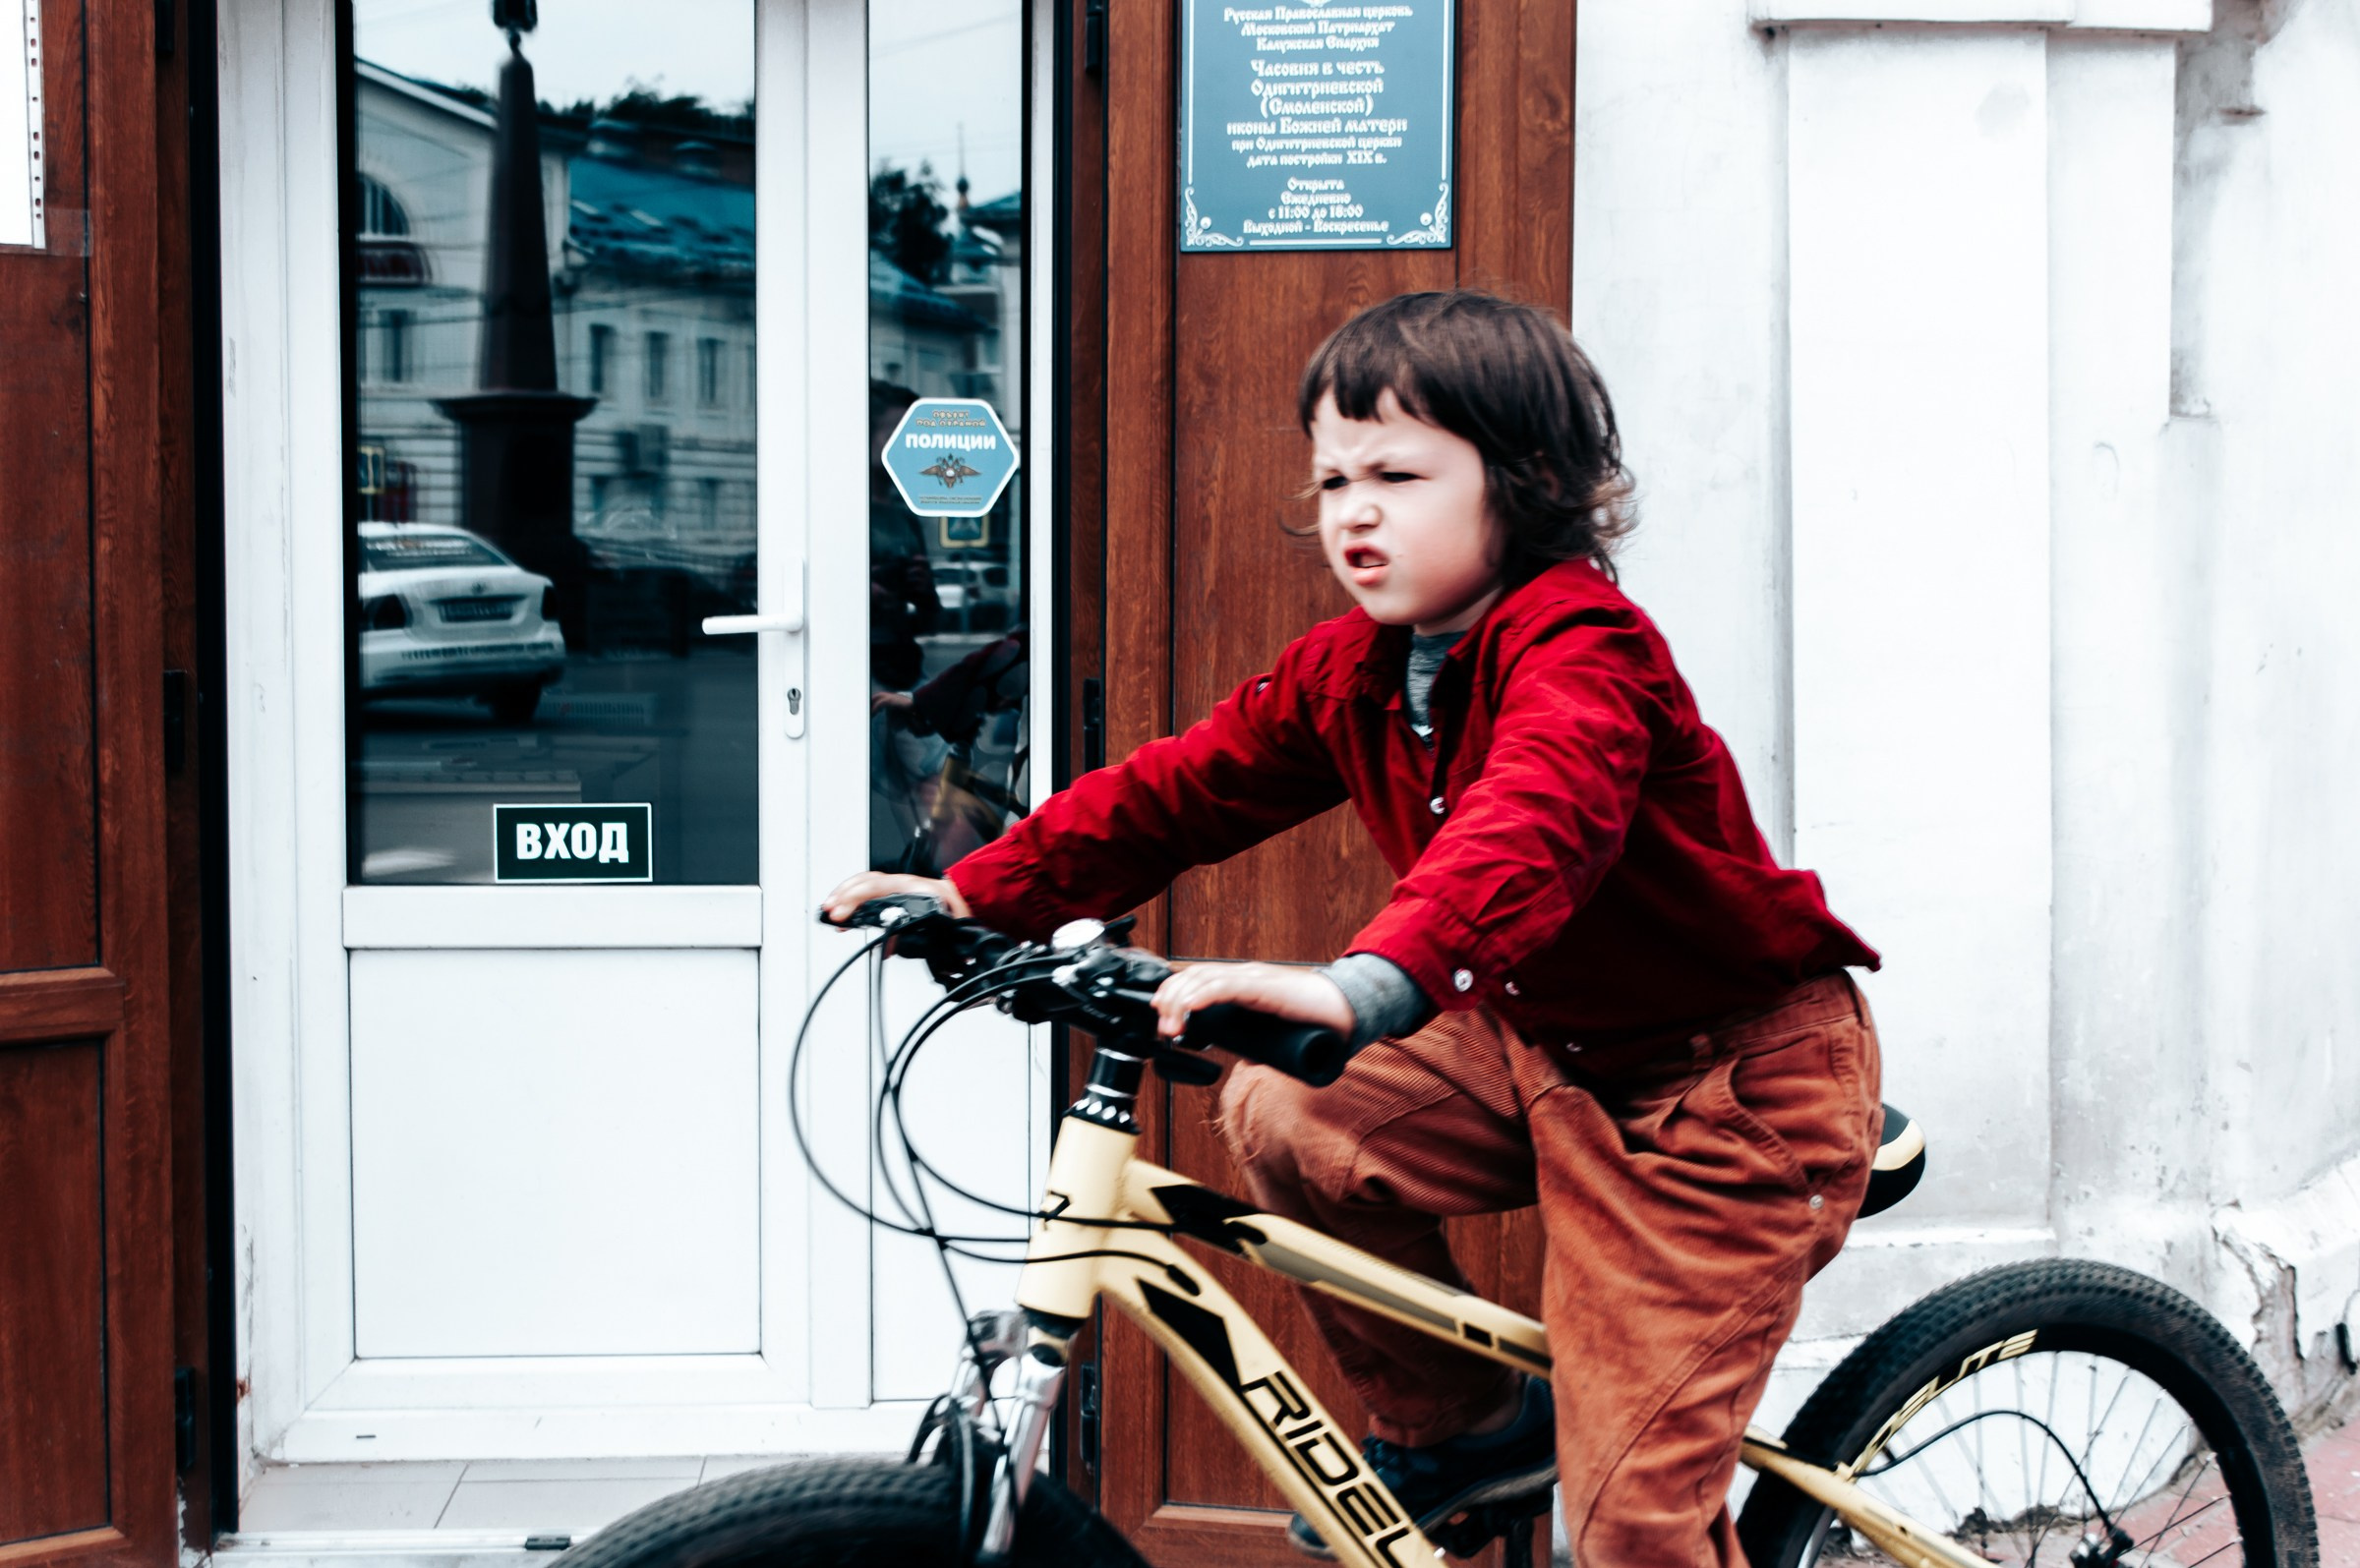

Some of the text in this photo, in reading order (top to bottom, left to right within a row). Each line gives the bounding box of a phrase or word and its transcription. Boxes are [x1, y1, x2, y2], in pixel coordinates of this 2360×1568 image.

[1223, 5, 1413, 24] Русская Православная церковь
[1241, 20, 1395, 36] Московский Патриархат
[1258, 35, 1379, 53] Калужская Епархия
[1251, 59, 1385, 76] Часовня в честь
[1251, 78, 1384, 98] Одигитриевской
[1260, 96, 1374, 117] (Смоленской)
[1226, 119, 1275, 136] иконы
[1344, 118, 1407, 137] матери
[1231, 136, 1402, 153] при Одигитриевской церкви
[1246, 150, 1387, 168] дата постройки XIX в.
[1287, 177, 1344, 194] Открыта
[1280, 192, 1351, 205] Ежедневно
[1268, 204, 1364, 221] с 11:00 до 18:00
[1243, 218, 1303, 237] Выходной
[1314, 217, 1388, 234] Воскресенье
[906, 434, 996, 451] ПОЛИЦИИ
[516, 822, 629, 863] ВХОД
